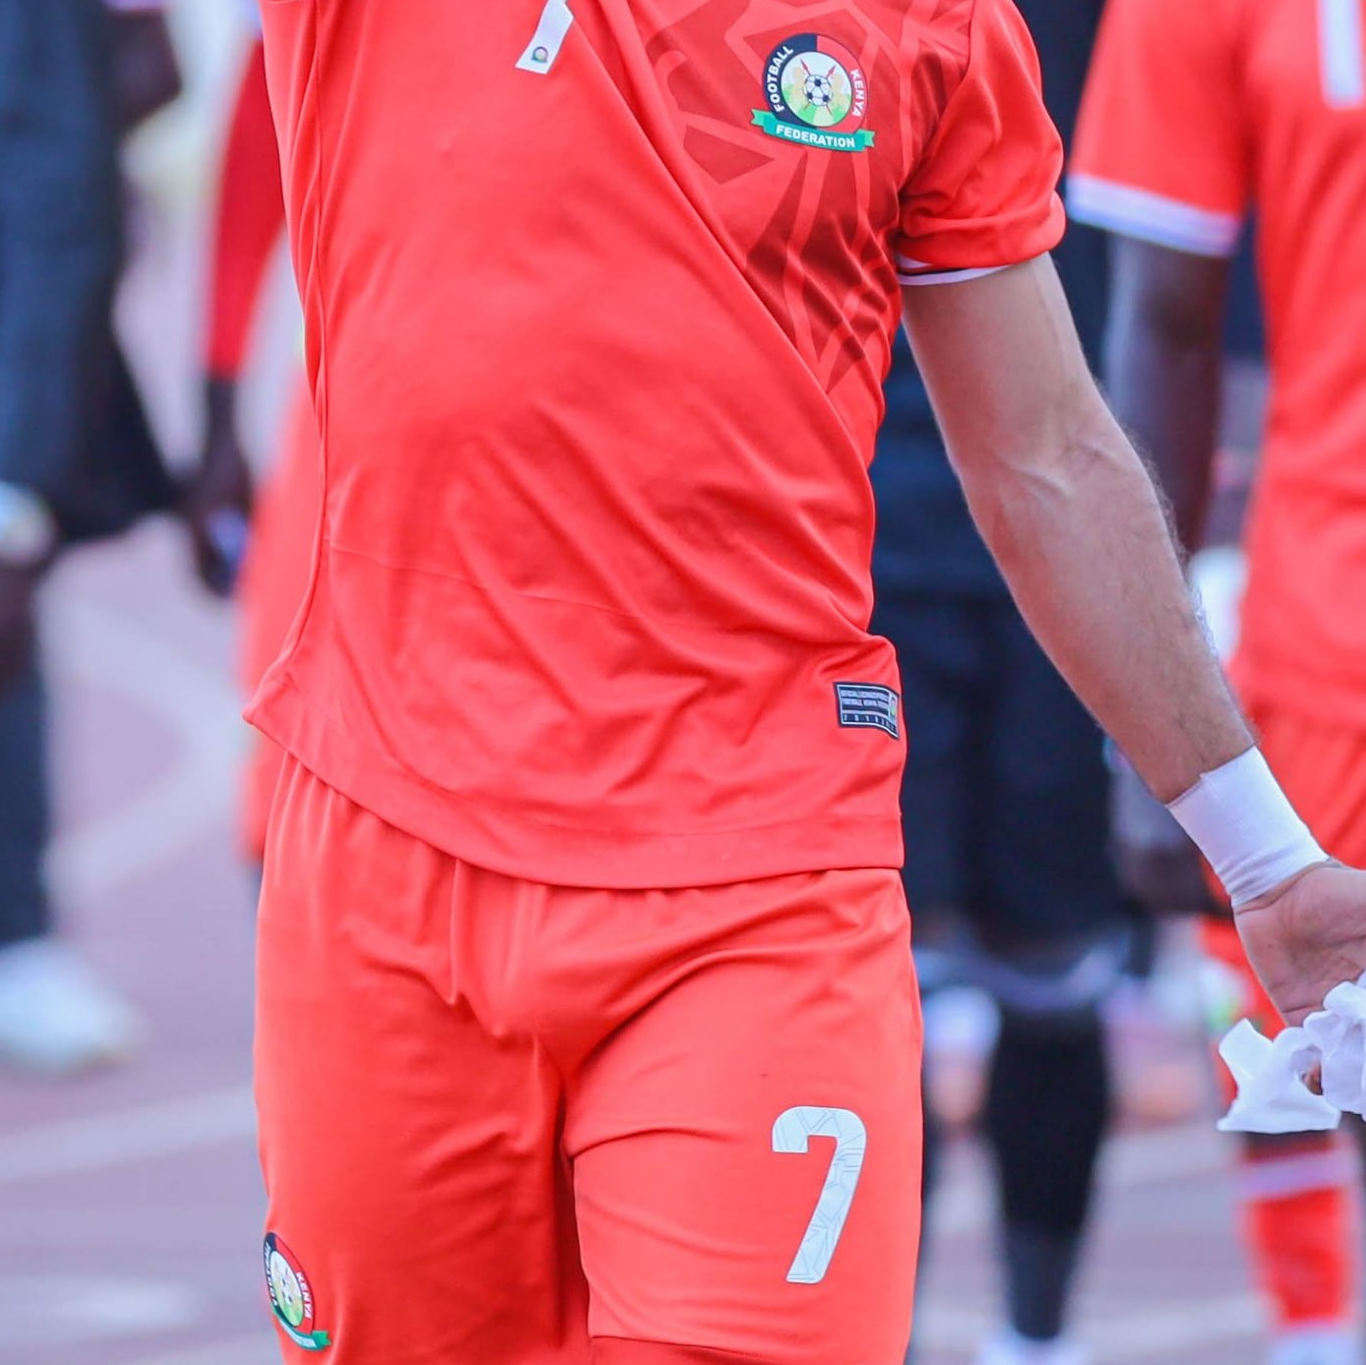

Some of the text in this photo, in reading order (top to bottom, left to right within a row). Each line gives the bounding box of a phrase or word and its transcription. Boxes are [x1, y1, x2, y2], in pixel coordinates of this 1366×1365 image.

[767, 45, 794, 113] FOOTBALL
[850, 69, 865, 117] KENYA
[776, 124, 855, 148] FEDERATION
[772, 1106, 866, 1284] 7
